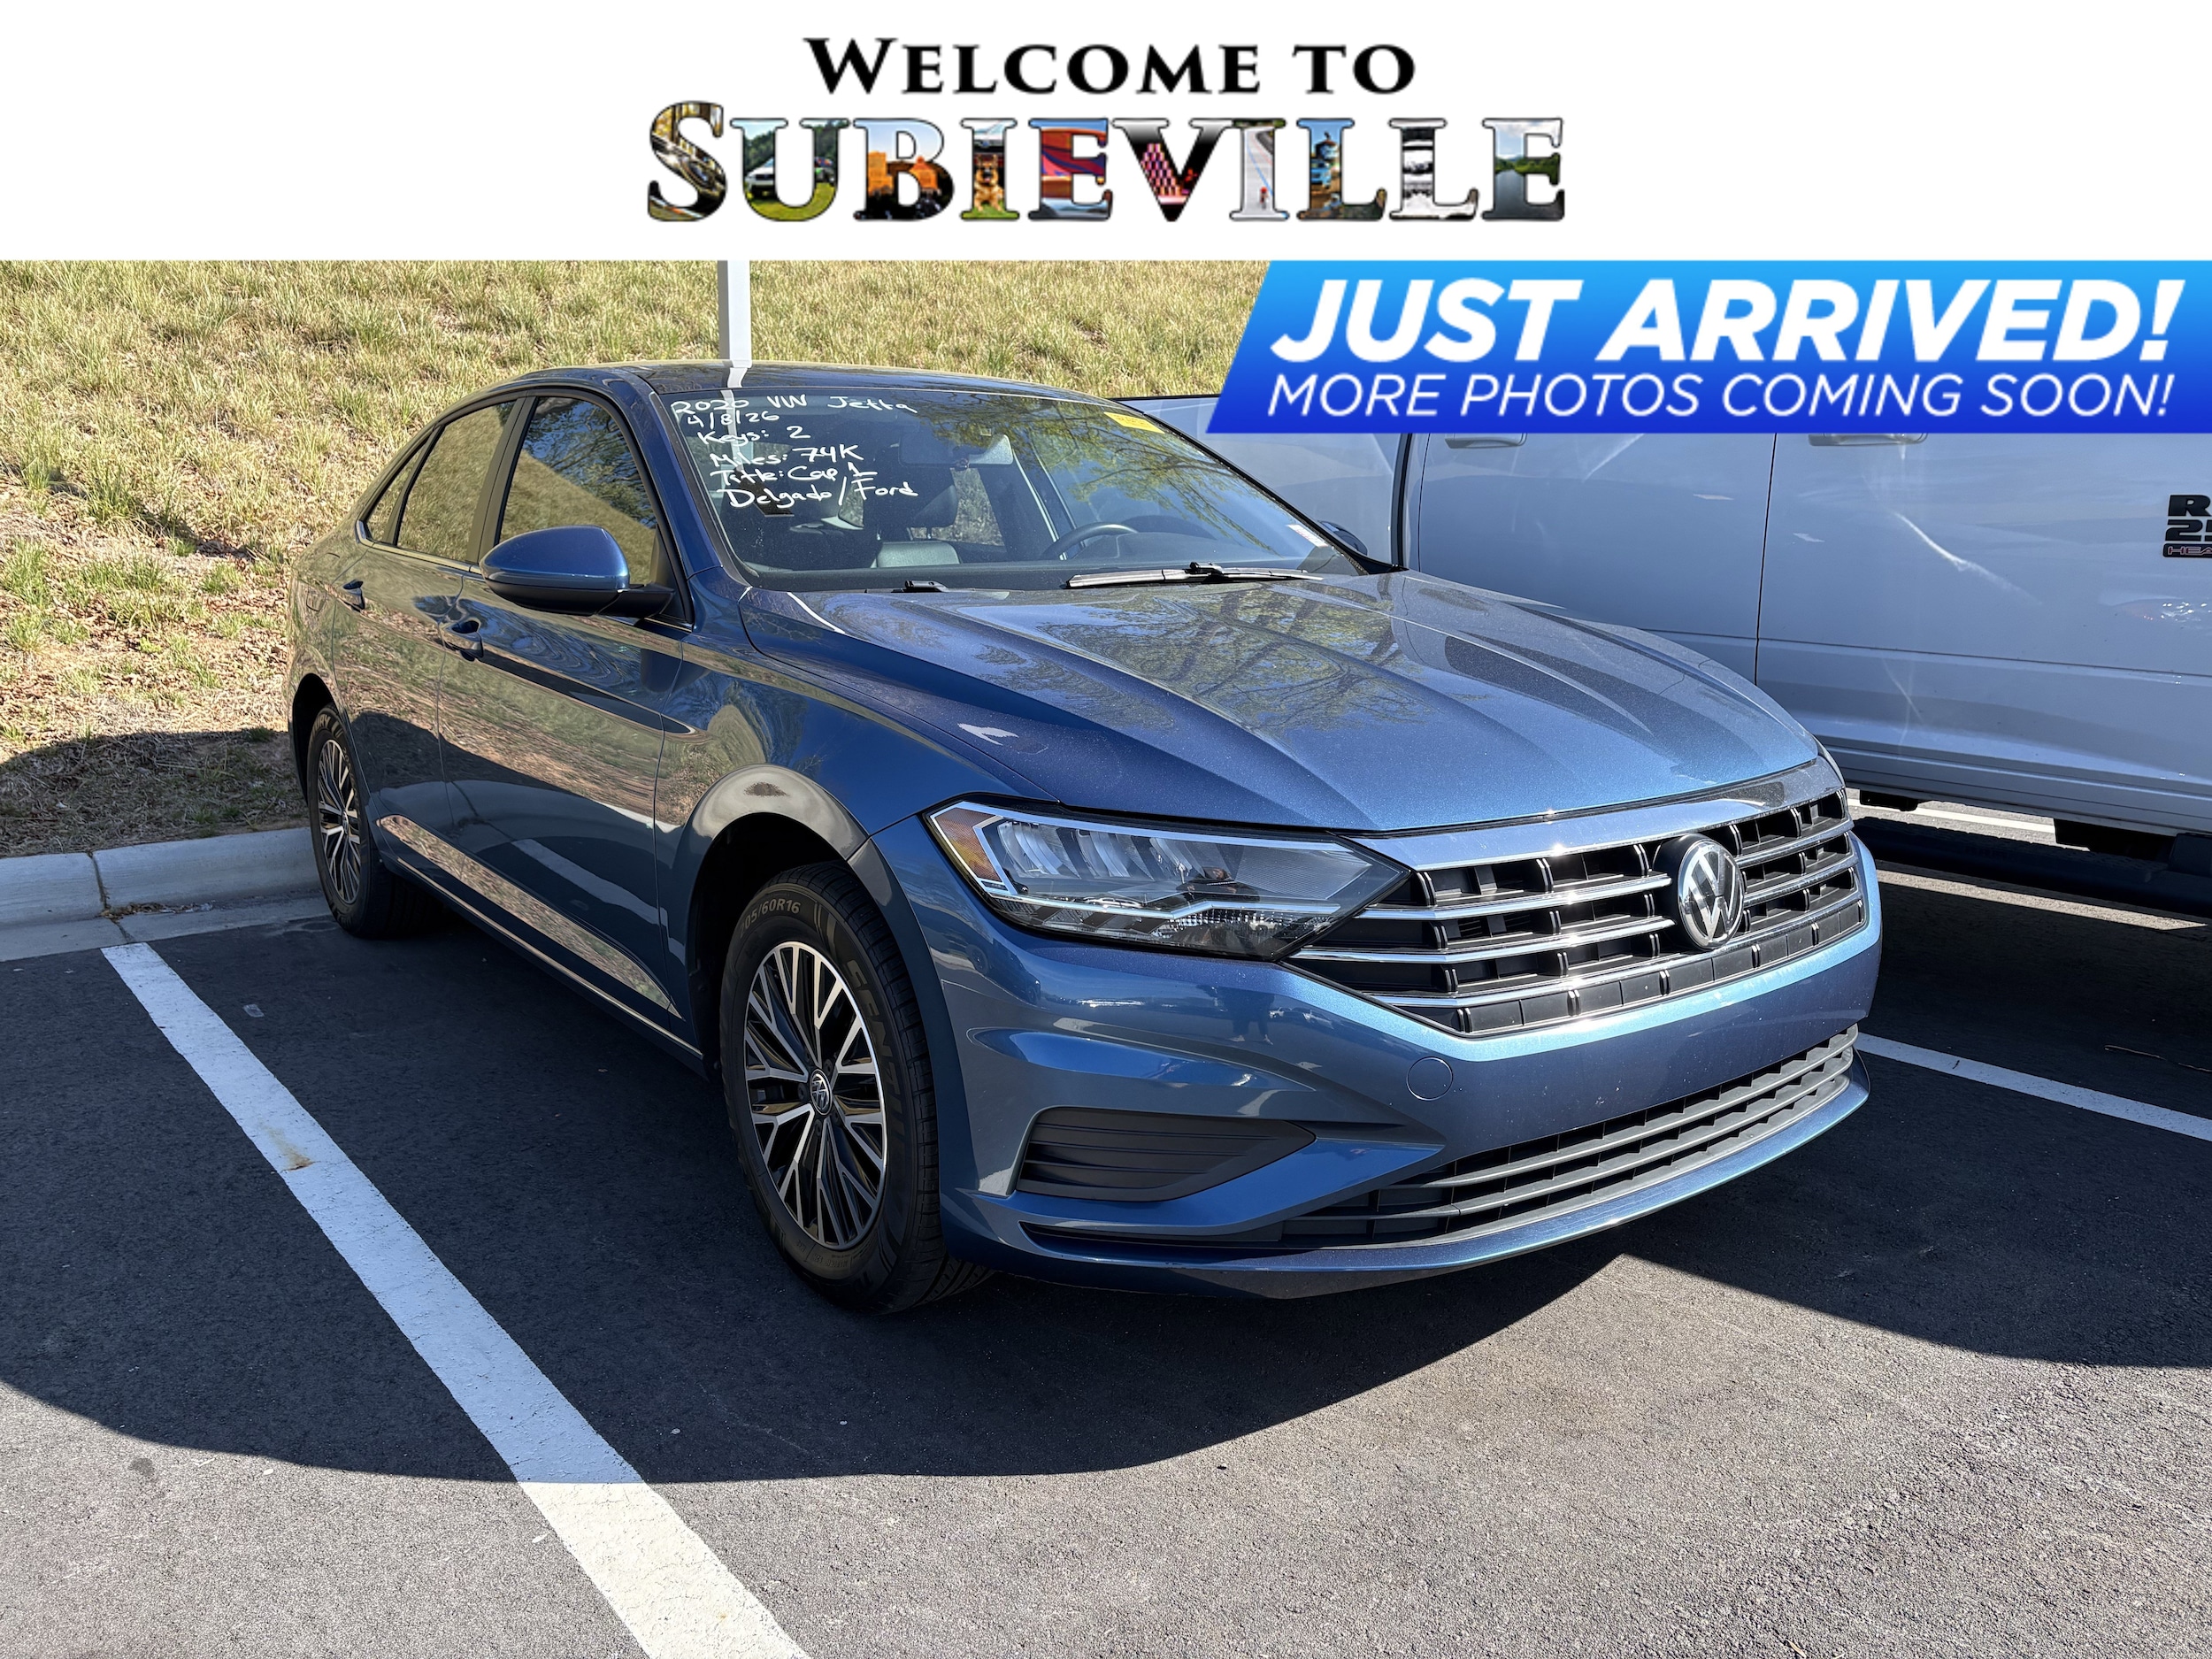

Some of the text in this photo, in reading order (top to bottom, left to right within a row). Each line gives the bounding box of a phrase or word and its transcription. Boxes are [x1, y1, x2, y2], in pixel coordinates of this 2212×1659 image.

[671, 395, 918, 415] 2020 VW Jetta
[697, 425, 811, 447] Keys: 2
[710, 452, 788, 467] Miles:
